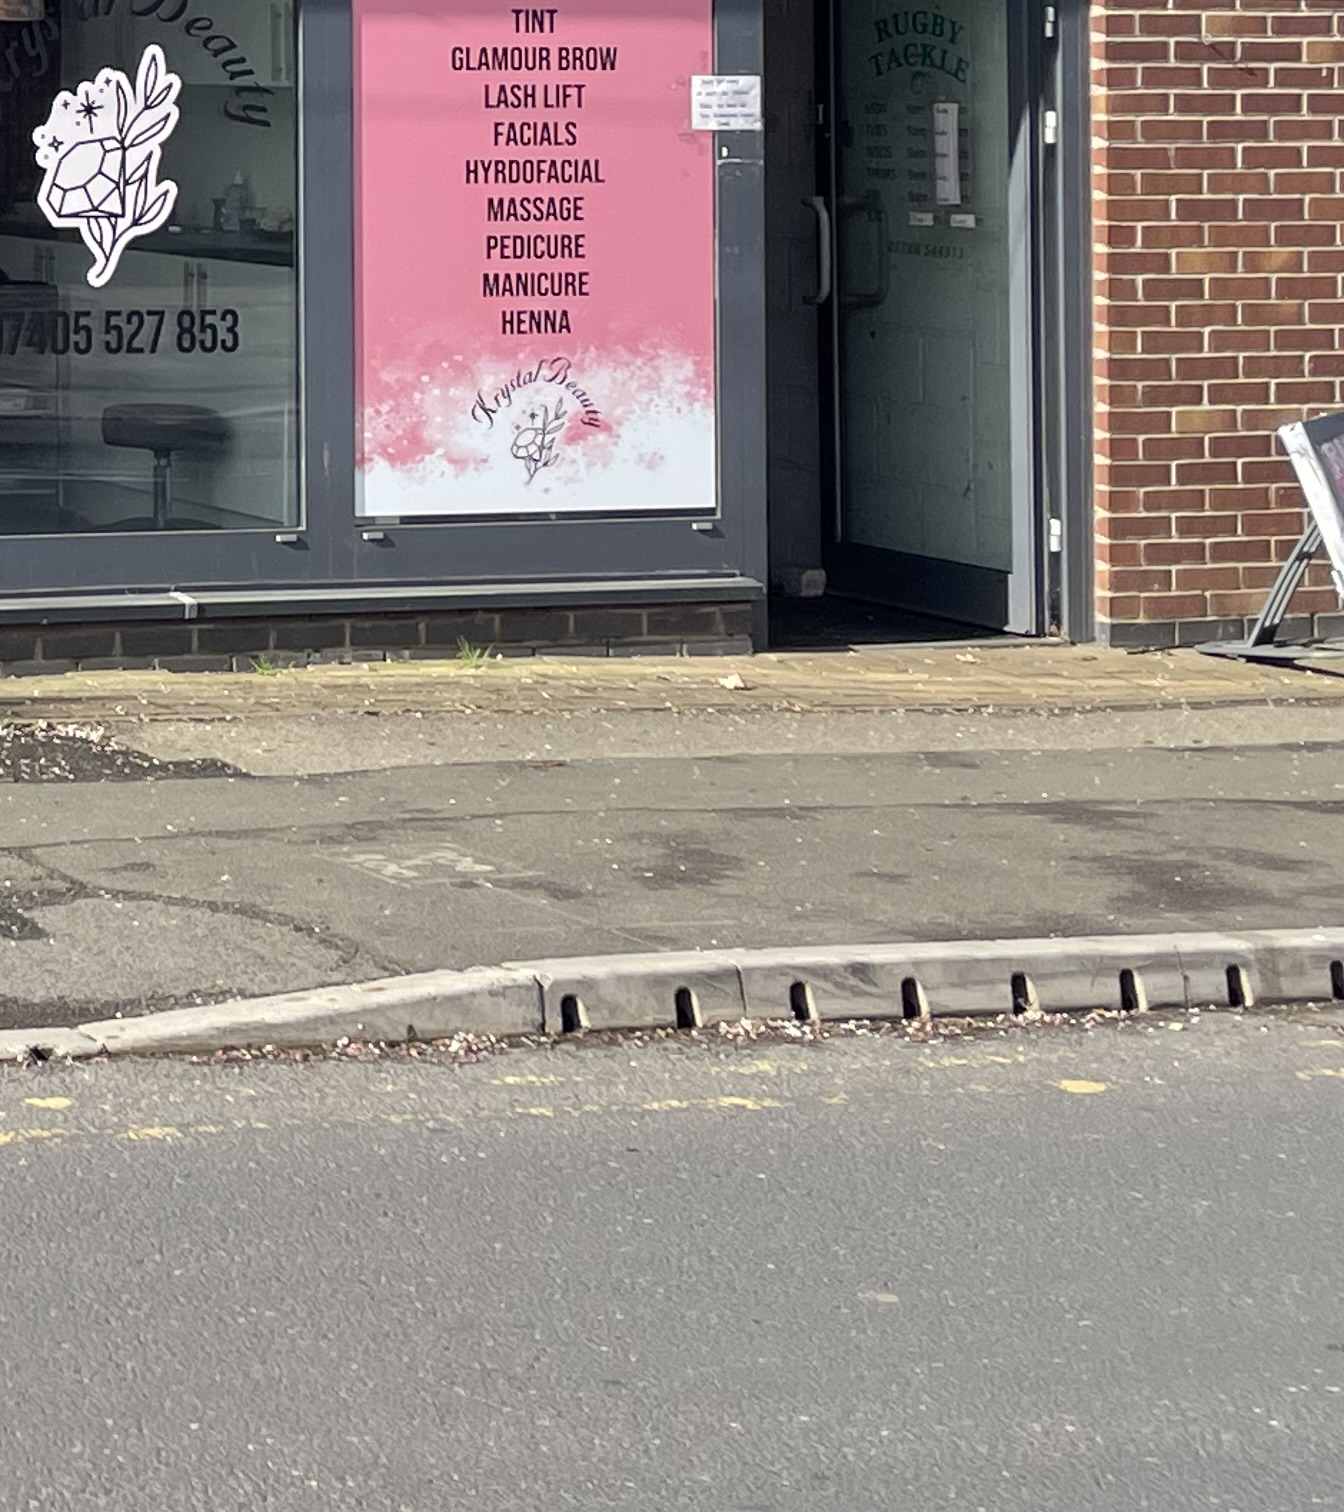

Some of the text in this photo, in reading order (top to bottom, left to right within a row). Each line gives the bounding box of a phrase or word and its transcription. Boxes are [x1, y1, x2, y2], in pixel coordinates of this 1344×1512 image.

[511, 8, 558, 34] TINT
[872, 10, 965, 46] RUGBY
[450, 46, 618, 72] GLAMOUR BROW
[867, 42, 970, 86] TACKLE
[483, 83, 587, 109] LASH LIFT
[492, 121, 578, 147] FACIALS
[464, 159, 606, 185] HYRDOFACIAL
[486, 196, 585, 222] MASSAGE
[485, 234, 587, 260] PEDICURE
[482, 271, 590, 298] MANICURE
[104, 308, 166, 355] 527
[175, 307, 239, 354] 853
[500, 309, 572, 336] HENNA
[471, 356, 601, 430] Krystal Beauty
